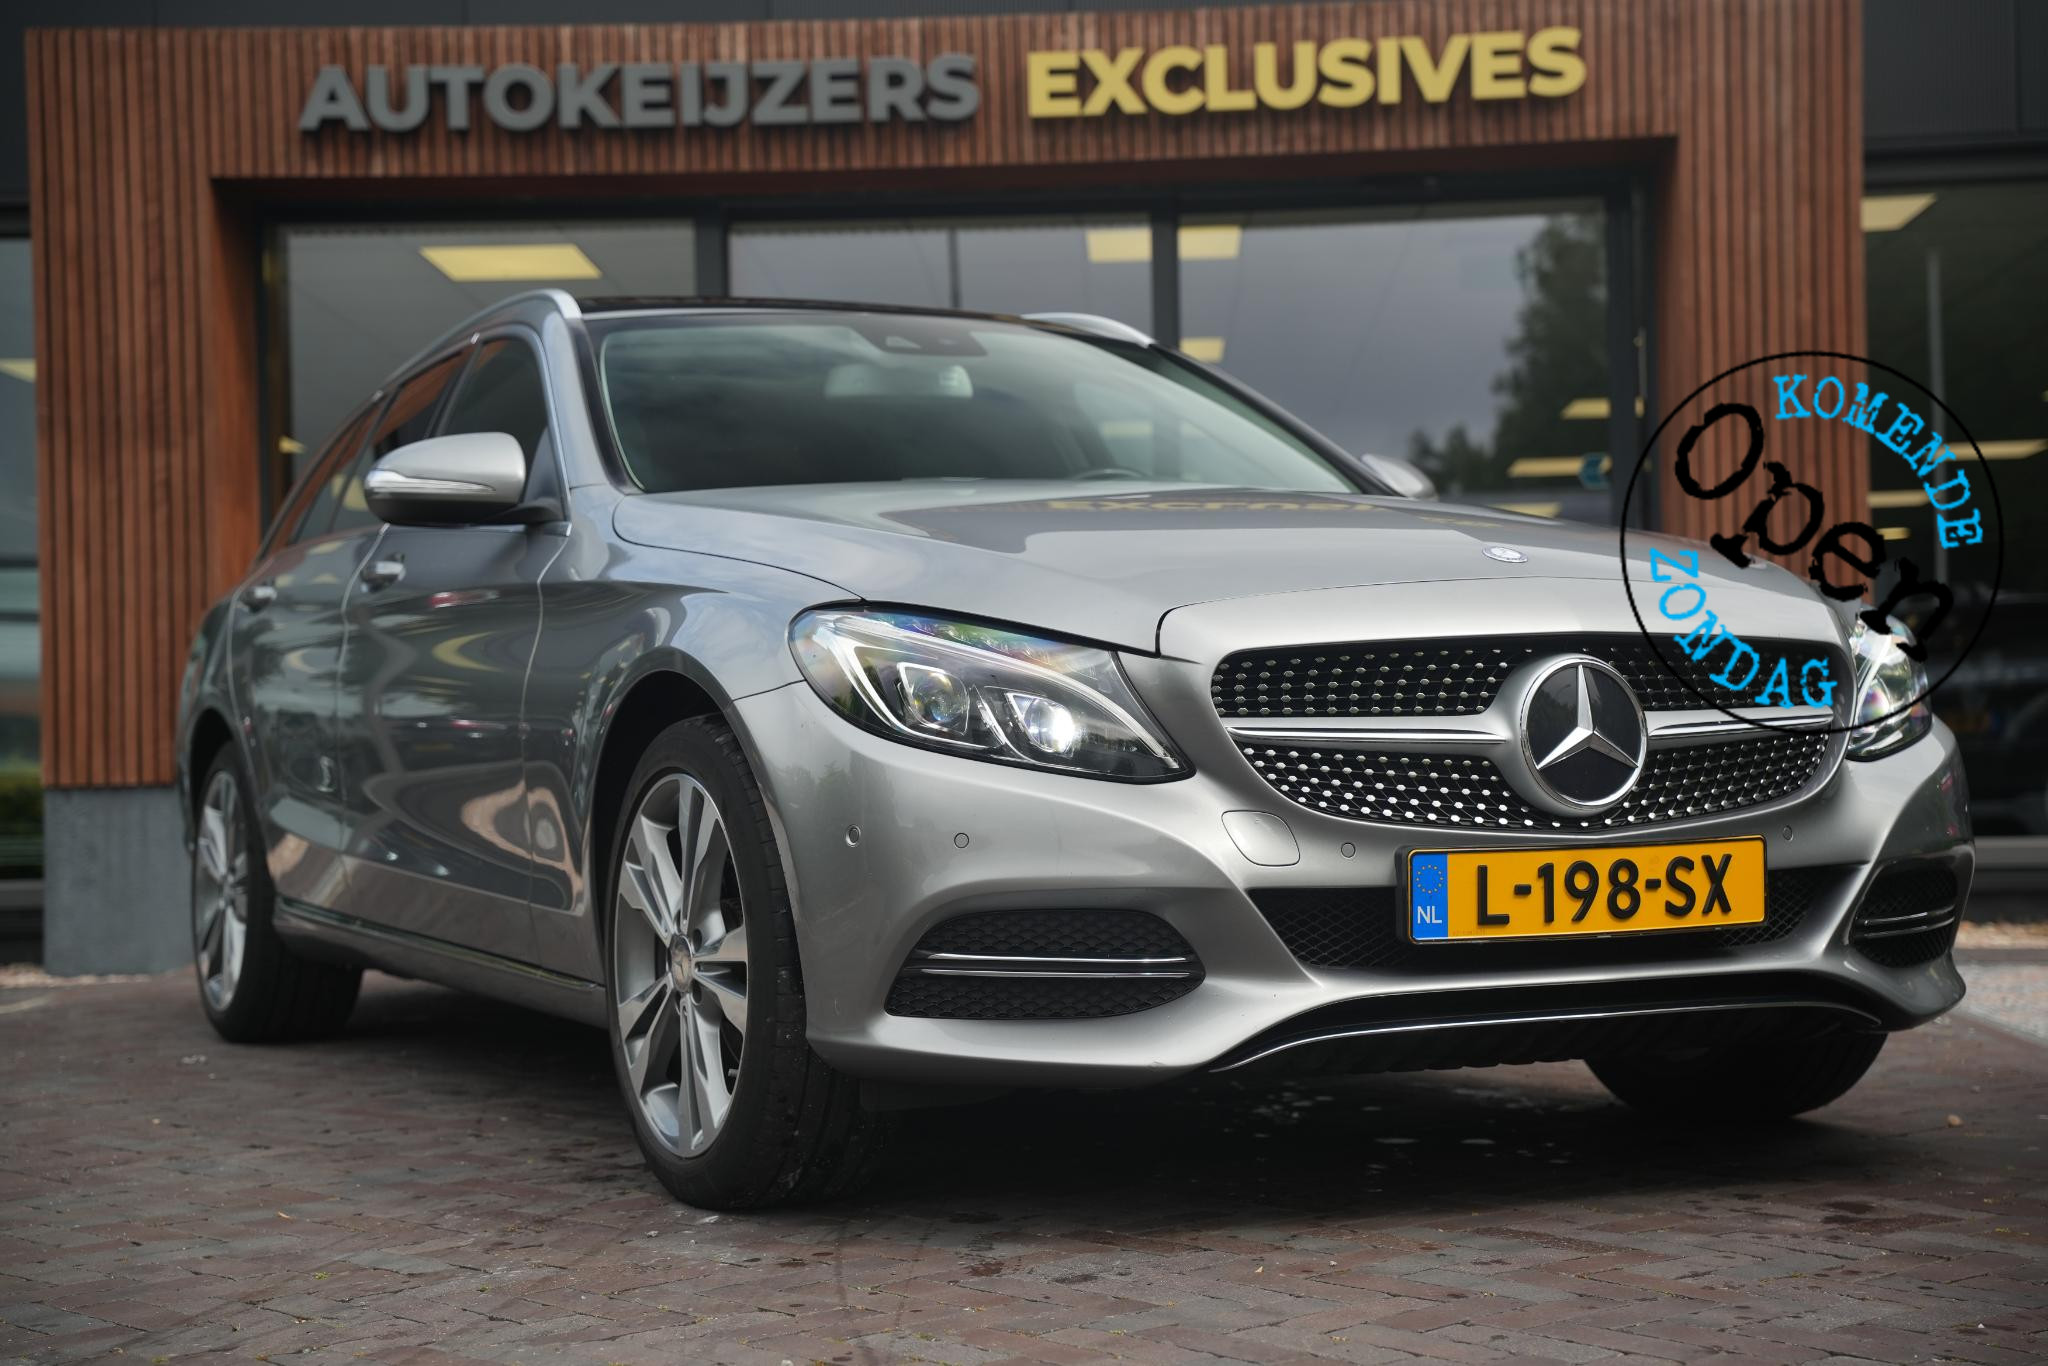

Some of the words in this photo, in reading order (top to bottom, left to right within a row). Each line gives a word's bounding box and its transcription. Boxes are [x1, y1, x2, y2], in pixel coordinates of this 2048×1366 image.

[299, 53, 980, 131] AUTOKEIJZERS
[1027, 26, 1587, 119] EXCLUSIVES
[1416, 905, 1442, 924] NL
[1476, 853, 1733, 926] L-198-SX
